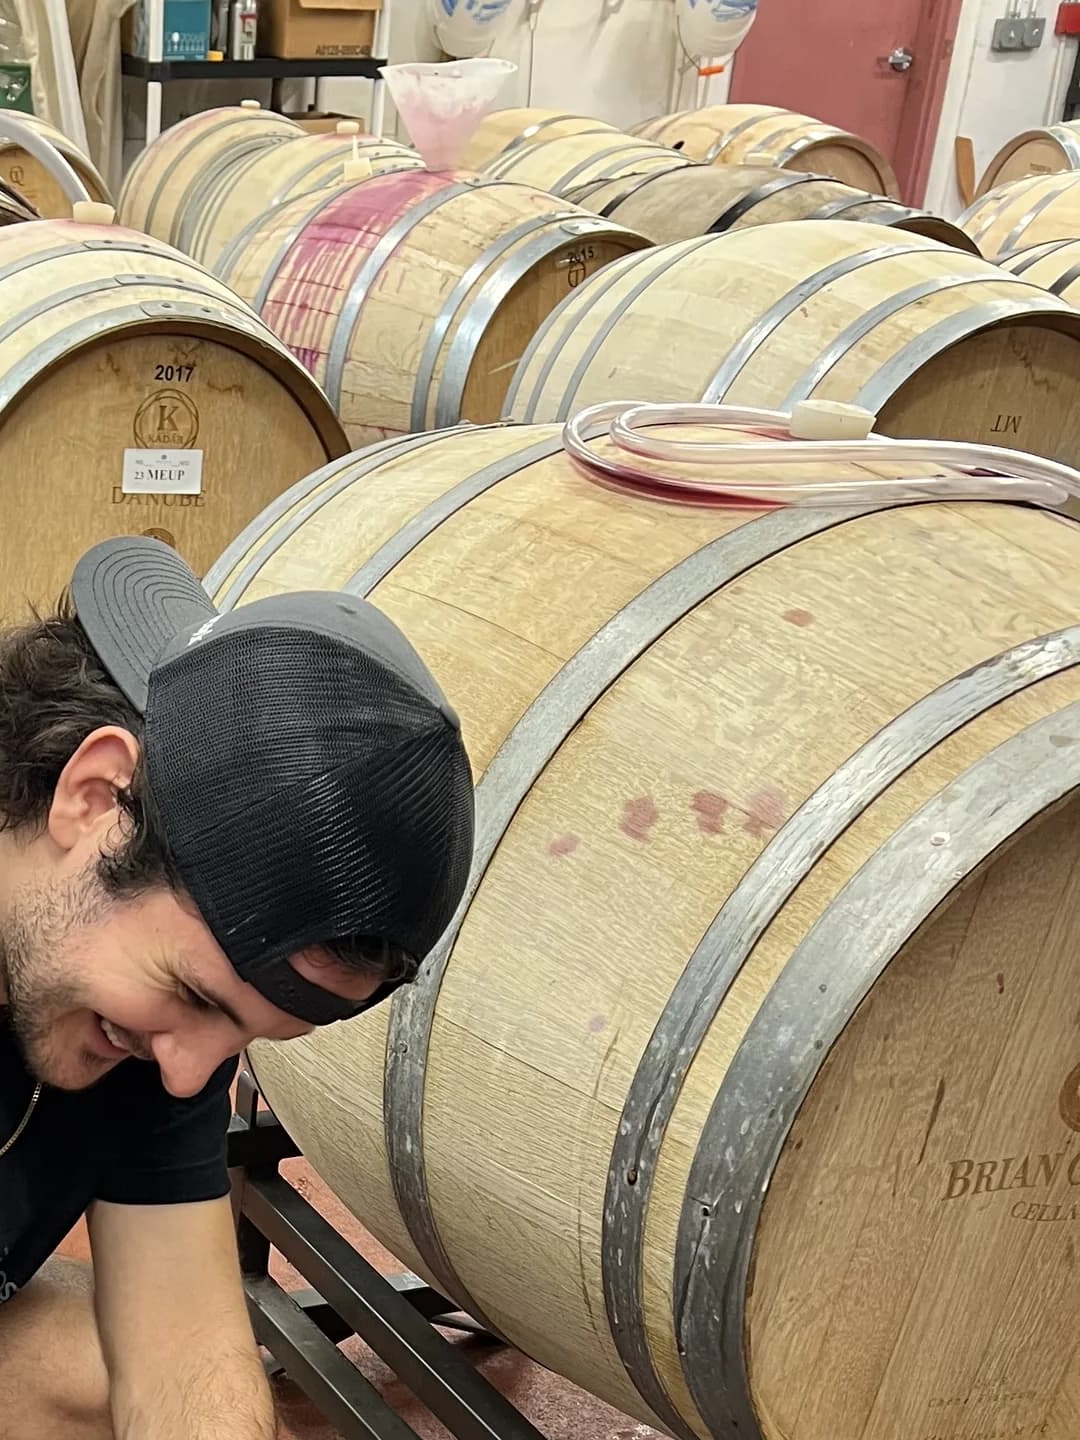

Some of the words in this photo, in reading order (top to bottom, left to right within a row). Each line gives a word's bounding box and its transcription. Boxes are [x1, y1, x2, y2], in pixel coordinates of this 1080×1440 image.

[154, 364, 195, 382] 2017
[990, 414, 1022, 433] MT
[147, 469, 185, 481] MEUP
